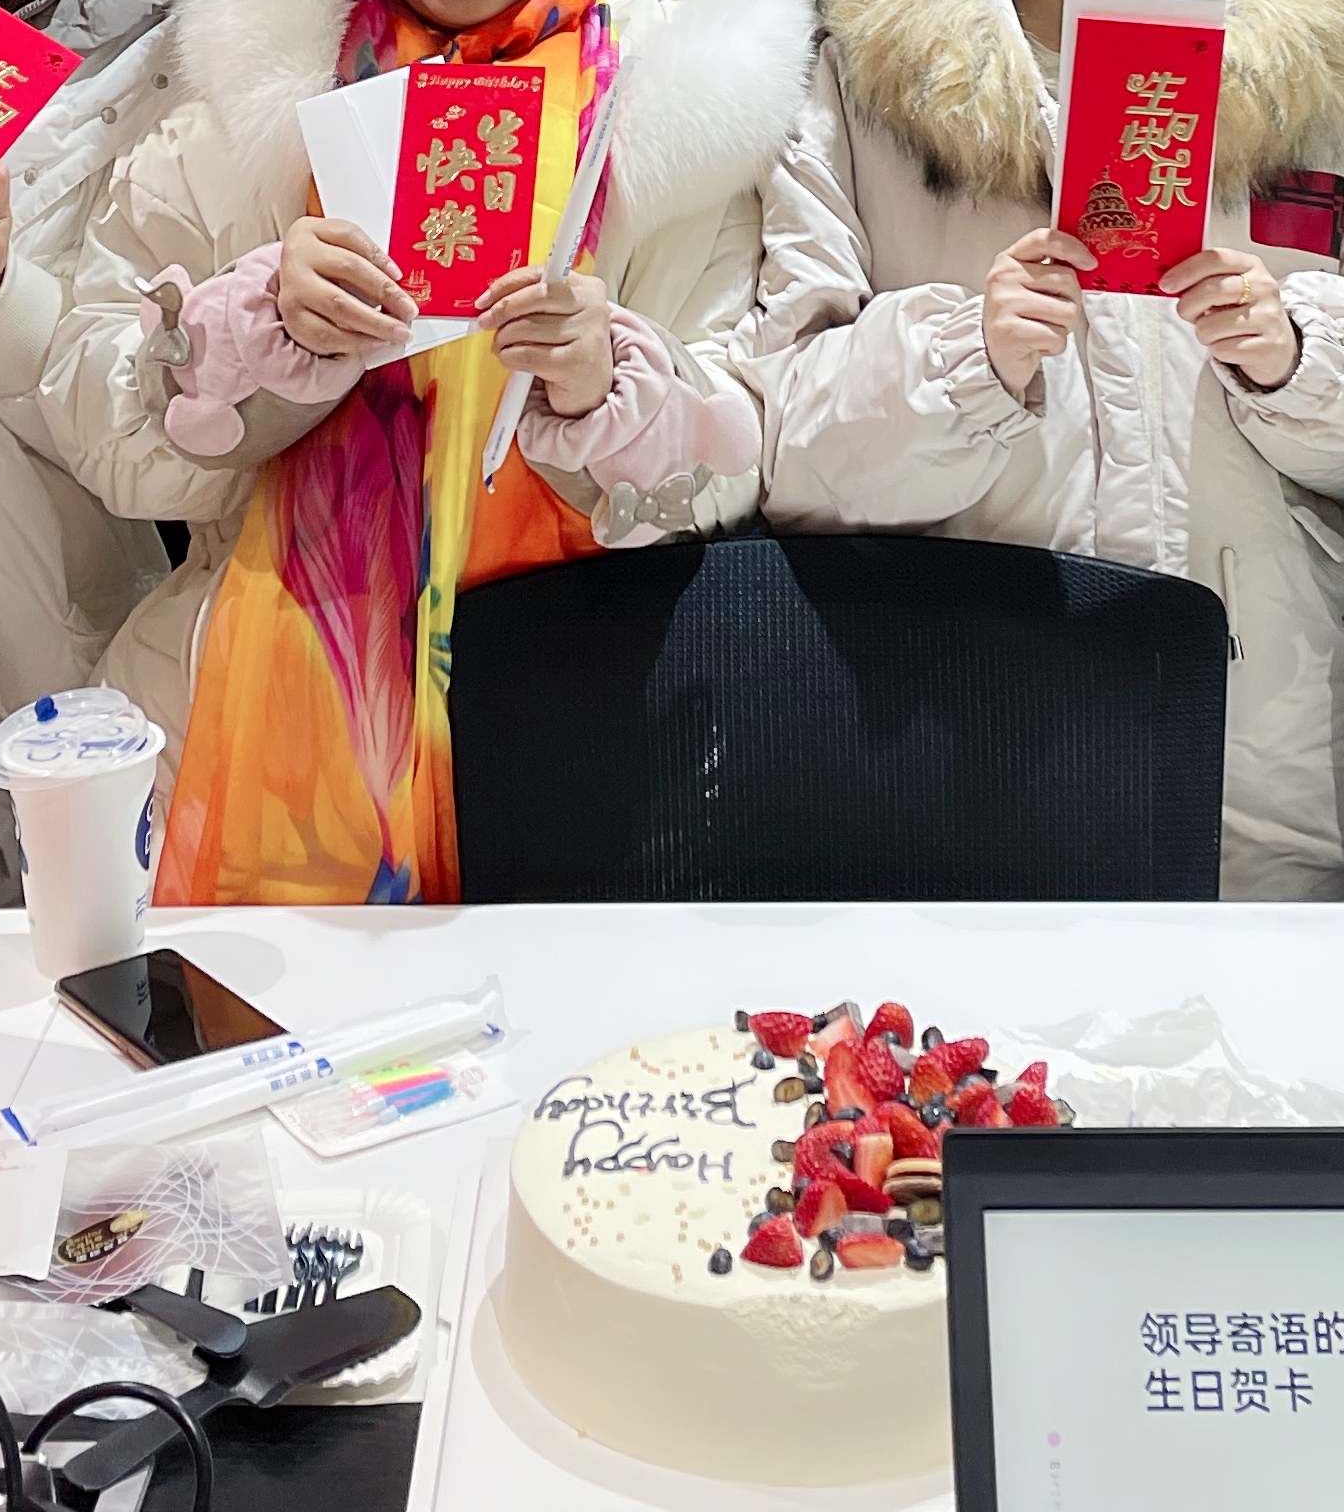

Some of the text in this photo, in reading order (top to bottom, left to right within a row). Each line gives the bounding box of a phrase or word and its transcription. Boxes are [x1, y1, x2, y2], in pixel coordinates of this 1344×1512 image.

[1118, 71, 1199, 210] 生日快乐
[533, 1074, 758, 1128] Birthday
[560, 1118, 734, 1182] Happy
[1145, 1367, 1315, 1413] 生日贺卡
